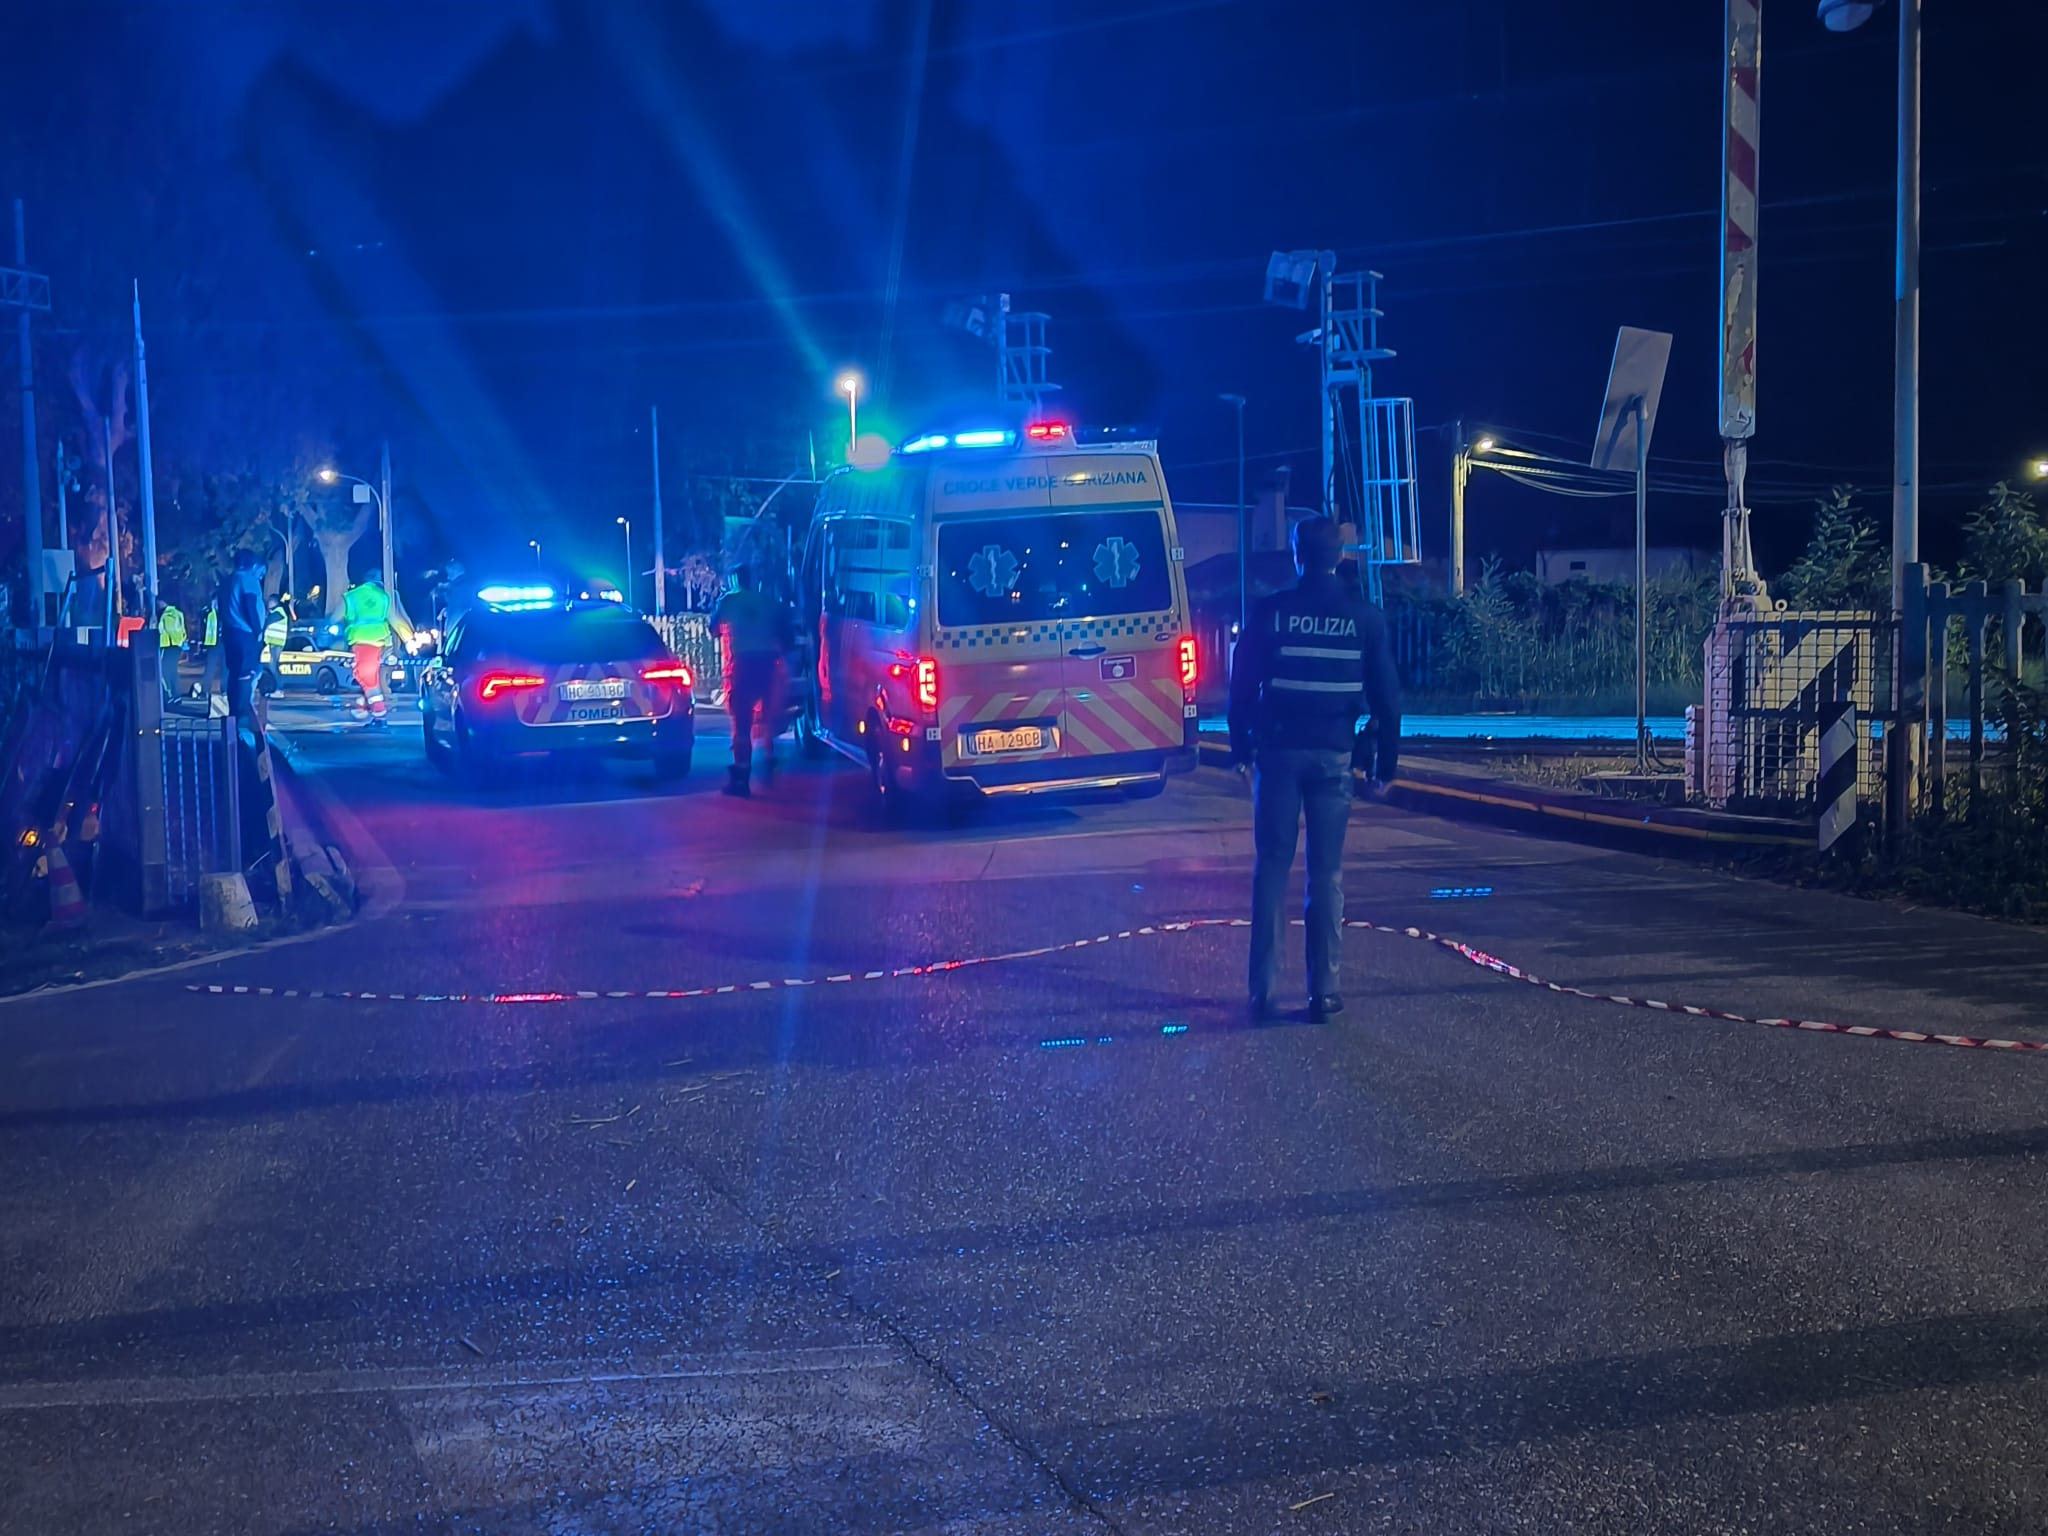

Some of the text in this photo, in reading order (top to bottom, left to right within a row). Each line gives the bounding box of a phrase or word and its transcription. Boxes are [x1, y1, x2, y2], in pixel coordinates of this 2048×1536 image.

[1005, 475, 1058, 491] VERDE
[1289, 616, 1357, 637] POLIZIA
[568, 687, 583, 699] HC
[977, 732, 1040, 750] HA 129CB
